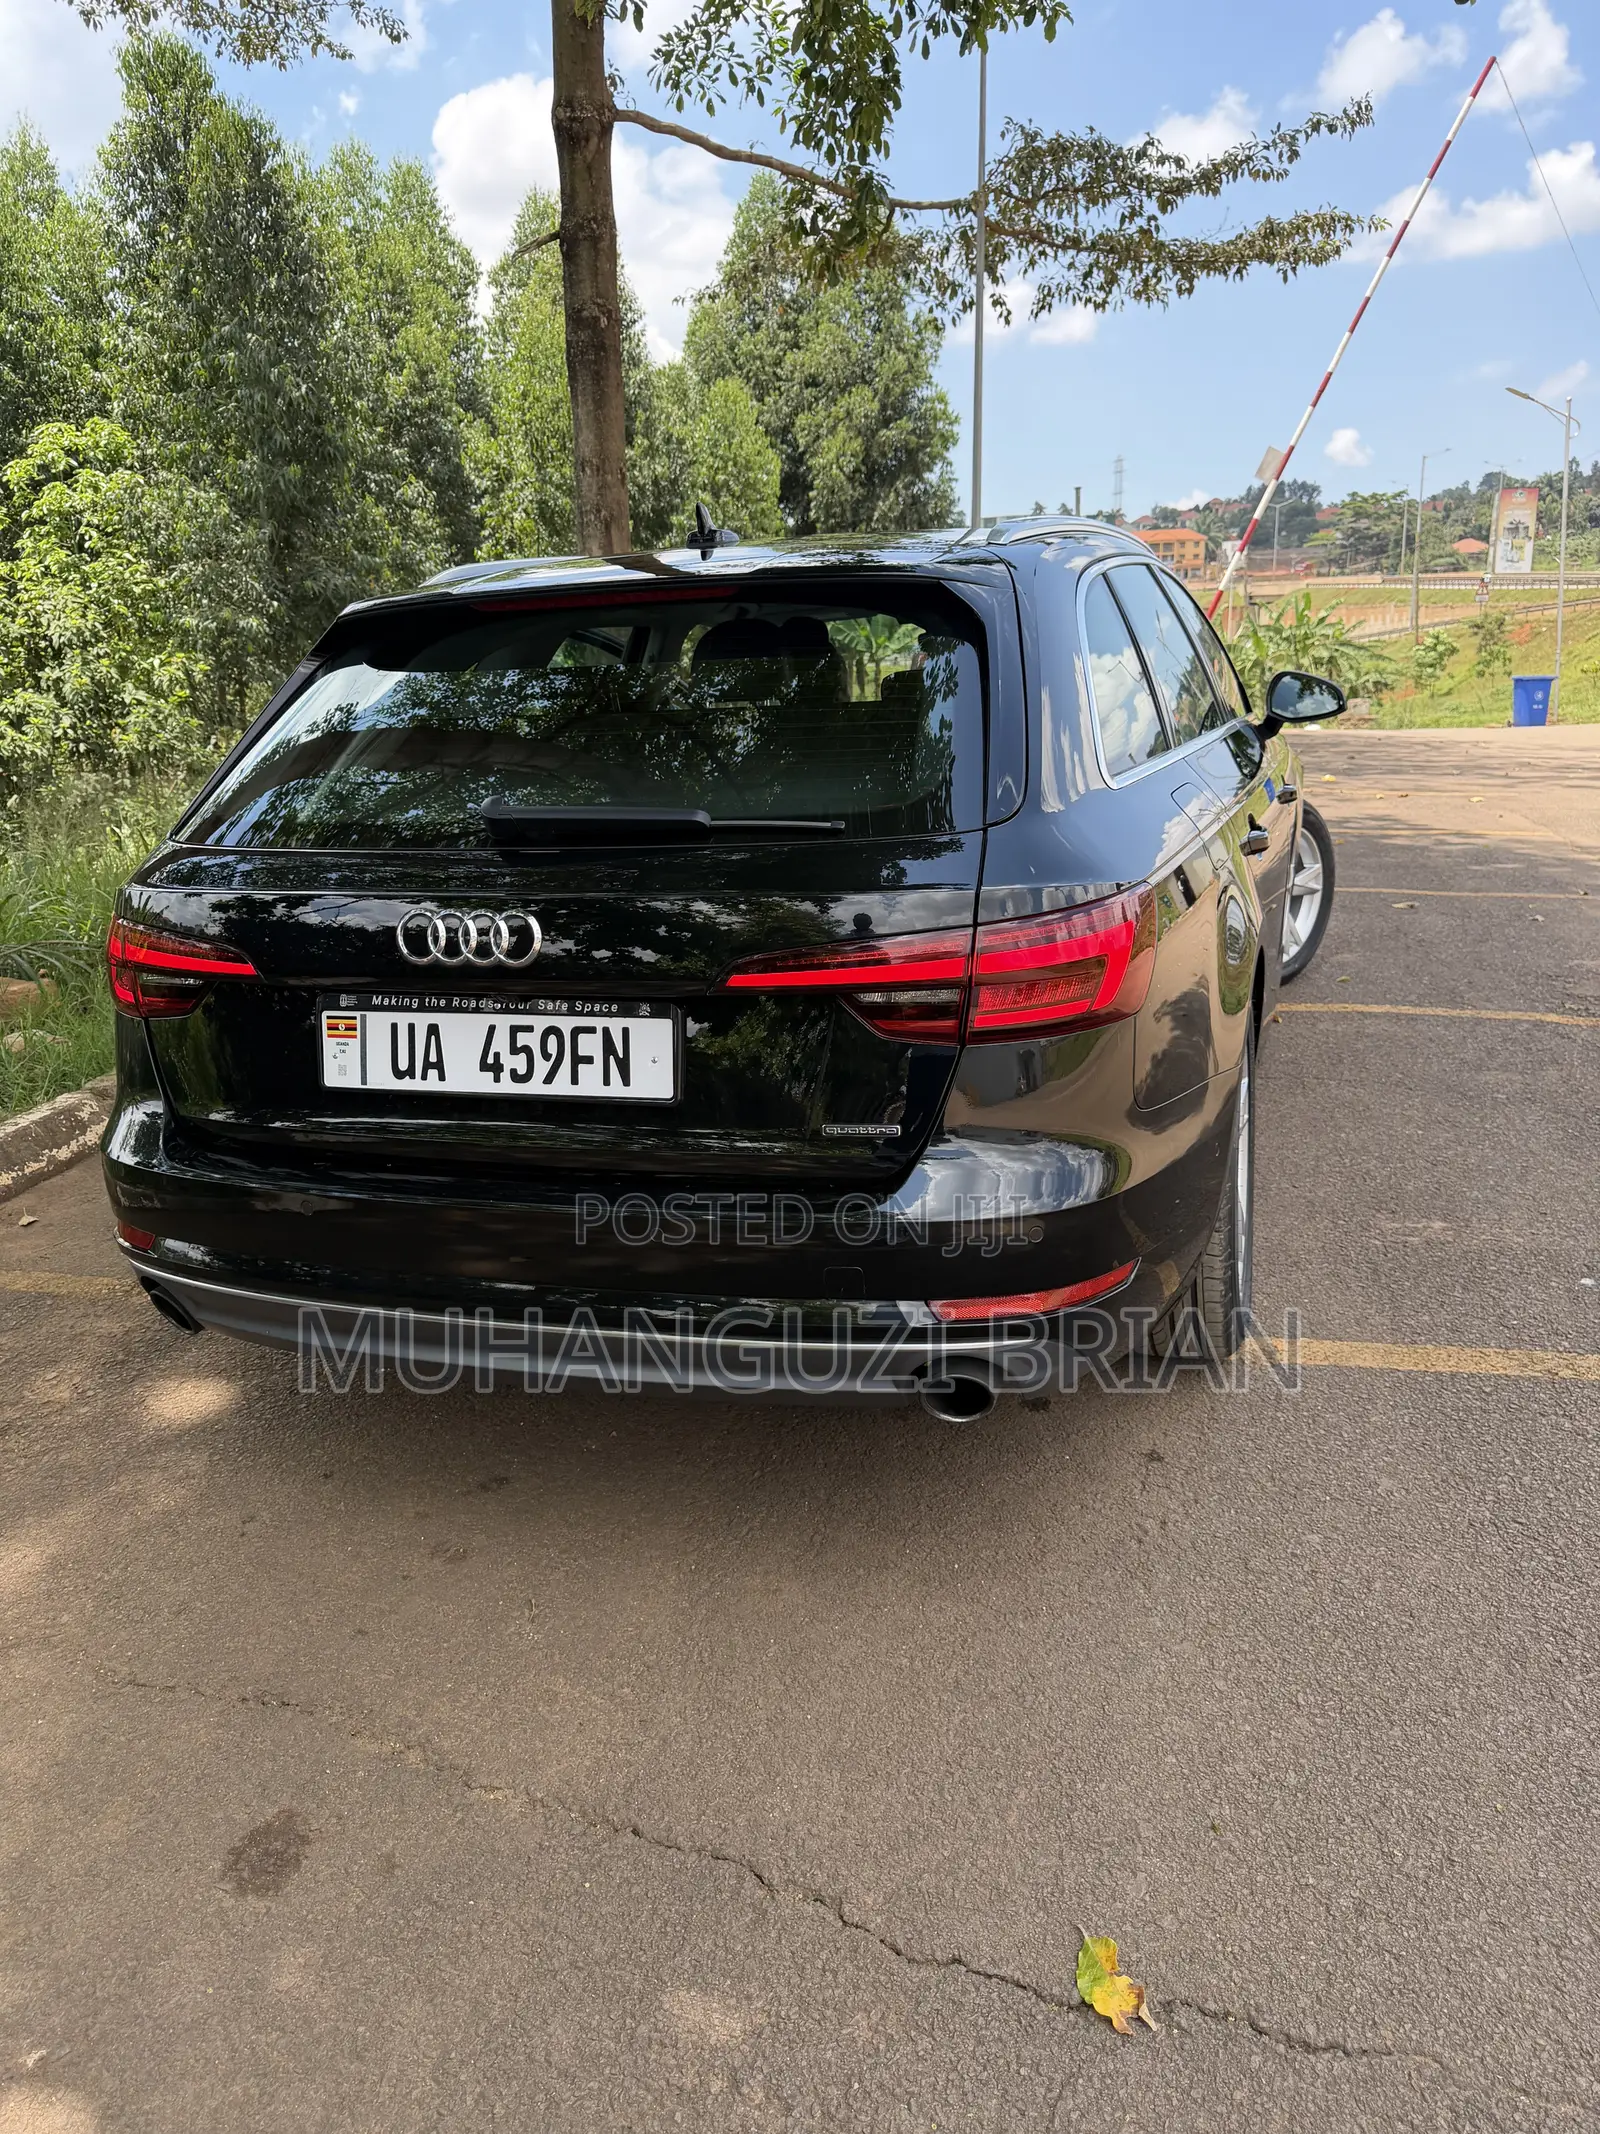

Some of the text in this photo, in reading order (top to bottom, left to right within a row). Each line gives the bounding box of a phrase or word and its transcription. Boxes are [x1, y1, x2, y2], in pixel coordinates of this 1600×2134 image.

[371, 994, 419, 1008] Making
[425, 996, 446, 1007] the
[452, 997, 494, 1009] Roads
[537, 999, 569, 1011] Safe
[574, 1001, 619, 1013] Space
[390, 1022, 632, 1087] UA 459FN
[825, 1126, 897, 1135] quattro
